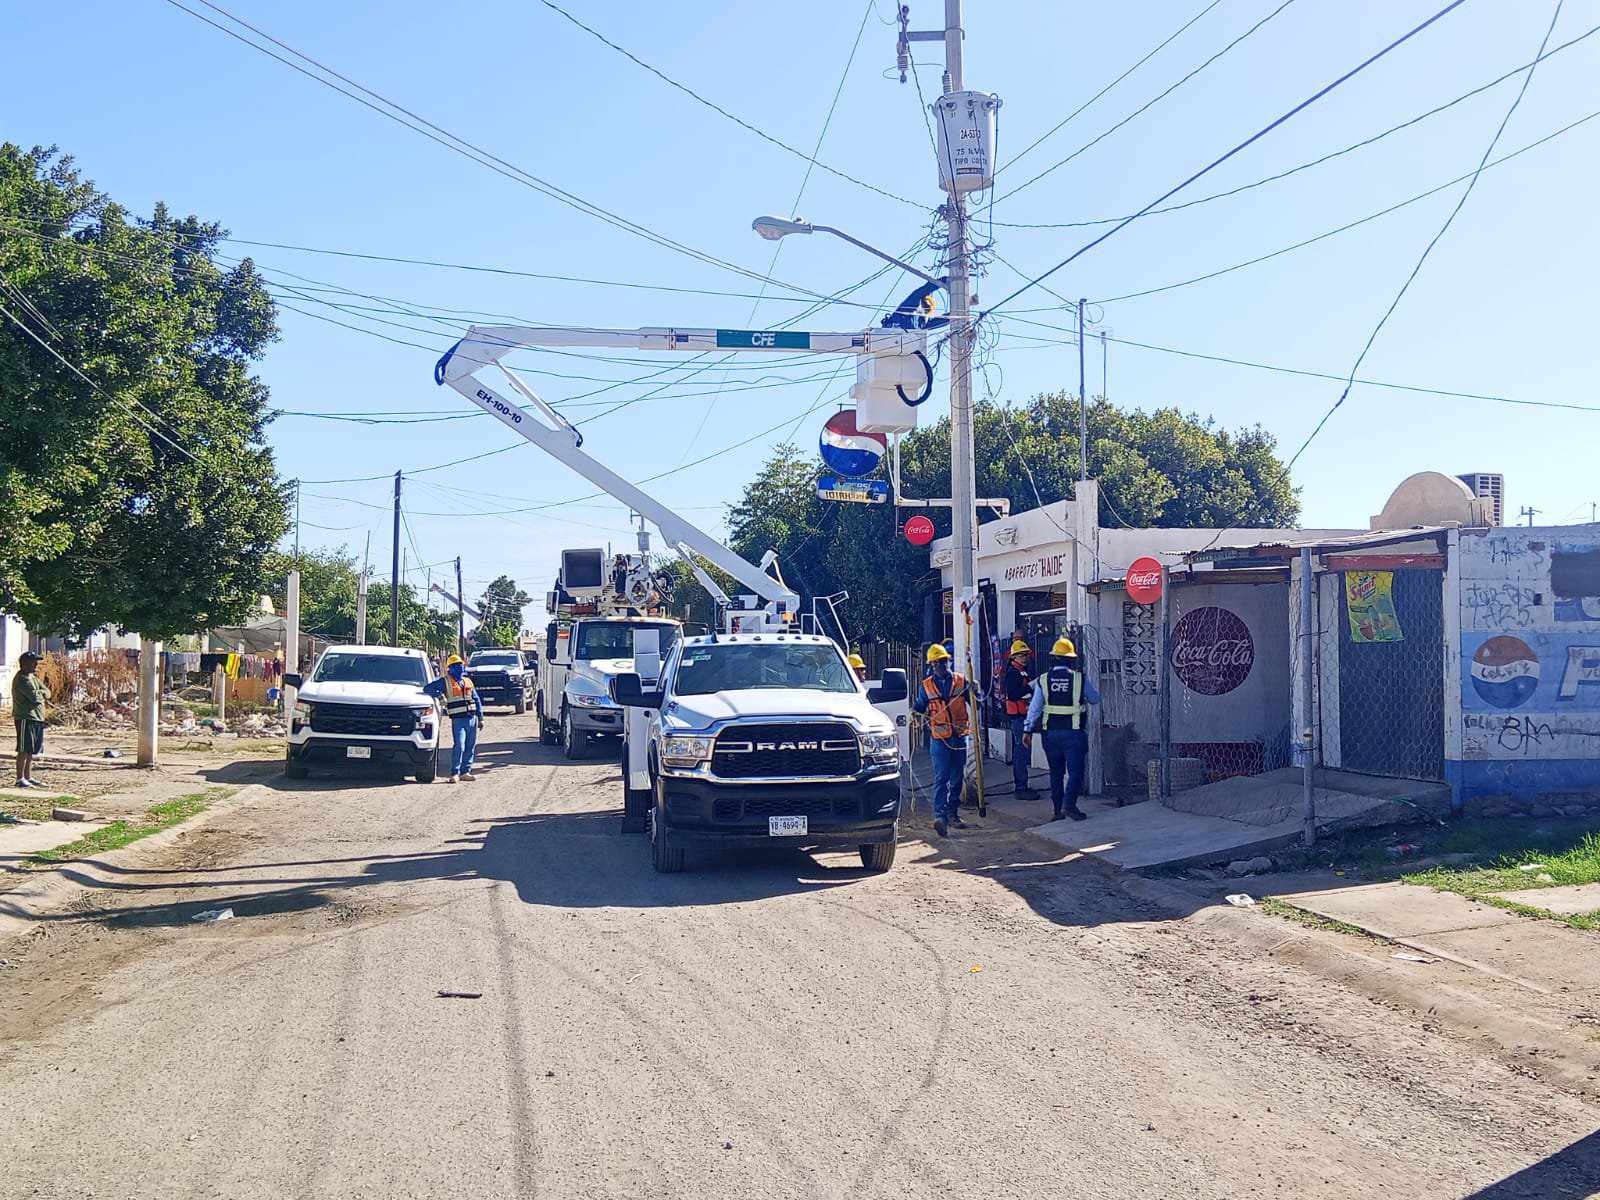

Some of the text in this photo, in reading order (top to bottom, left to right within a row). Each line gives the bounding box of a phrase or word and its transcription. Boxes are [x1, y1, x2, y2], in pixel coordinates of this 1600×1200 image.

[751, 332, 777, 347] CFE
[476, 389, 522, 424] EH-100-10
[1004, 563, 1038, 581] ABARROTES
[1051, 682, 1069, 692] CFE
[756, 742, 818, 751] RAM
